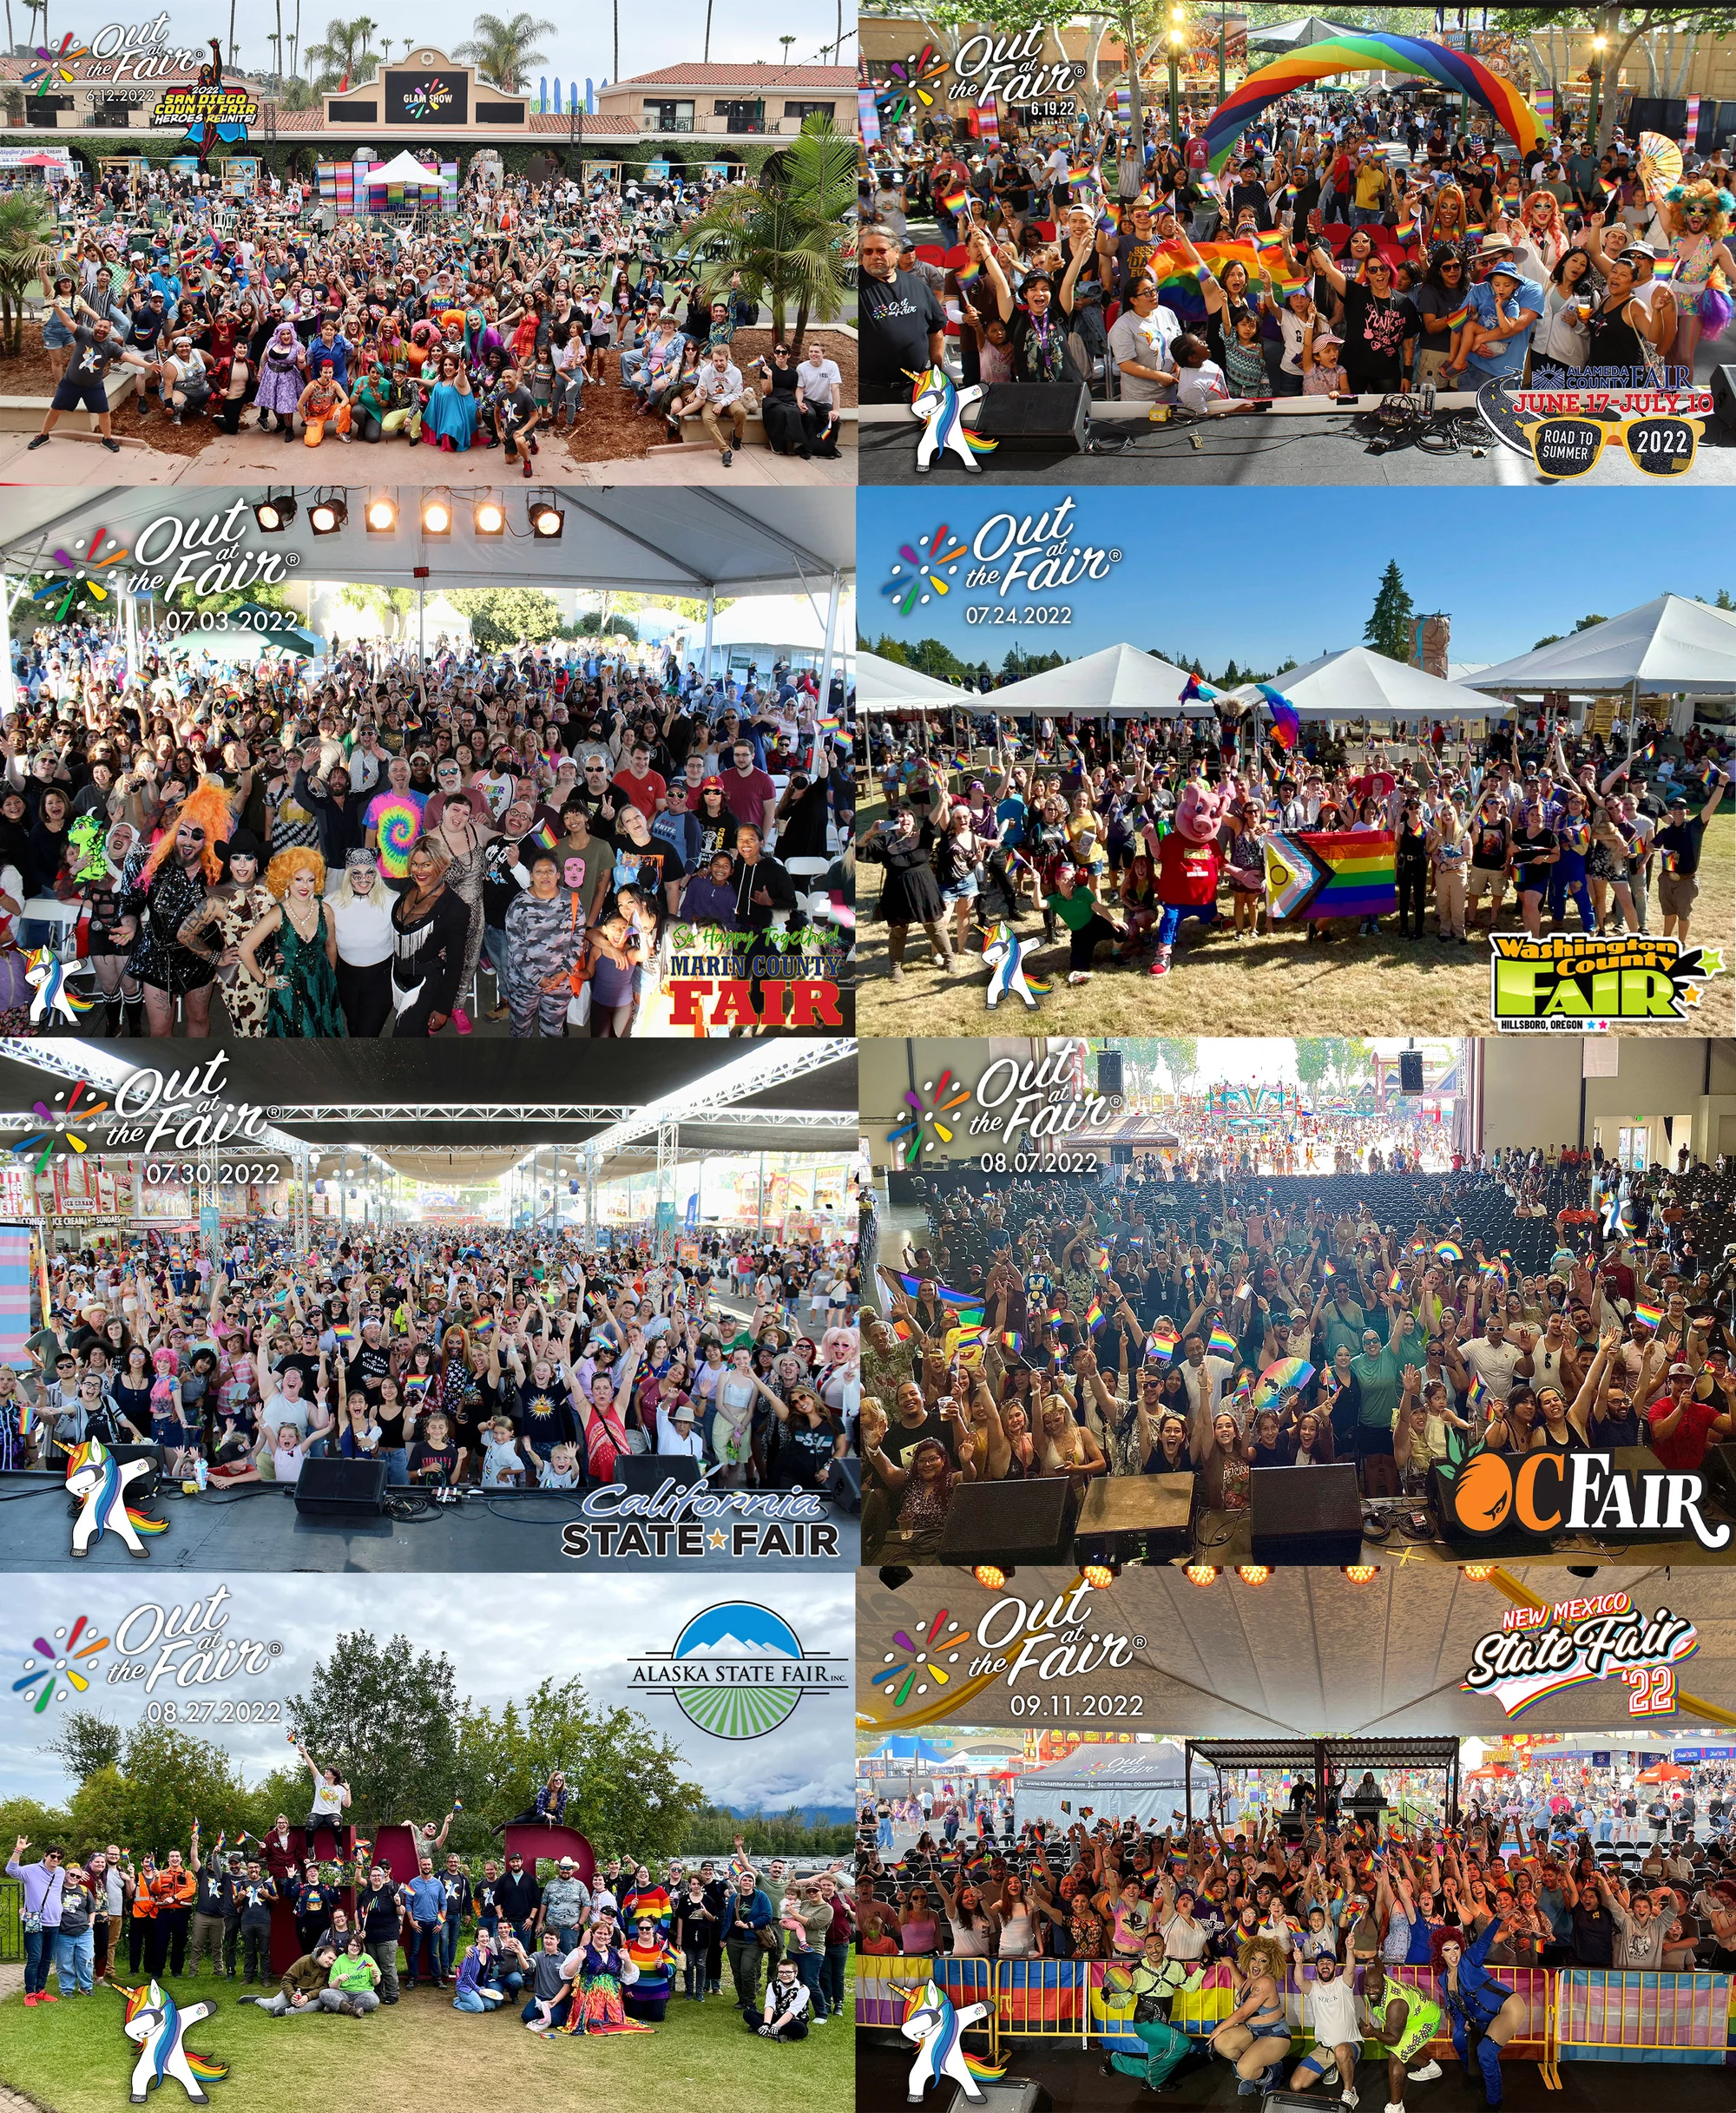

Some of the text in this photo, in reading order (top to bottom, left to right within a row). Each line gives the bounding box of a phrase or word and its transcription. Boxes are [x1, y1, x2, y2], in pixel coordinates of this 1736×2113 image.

[403, 94, 452, 103] GLAM SHOW
[1134, 246, 1155, 255] BEST
[415, 568, 429, 577] EXIT
[477, 783, 505, 793] QUEER
[654, 822, 676, 834] WHITE
[817, 1169, 843, 1179] SAUSAGE
[8, 1182, 23, 1195] ICE
[1108, 1754, 1147, 1768] Out
